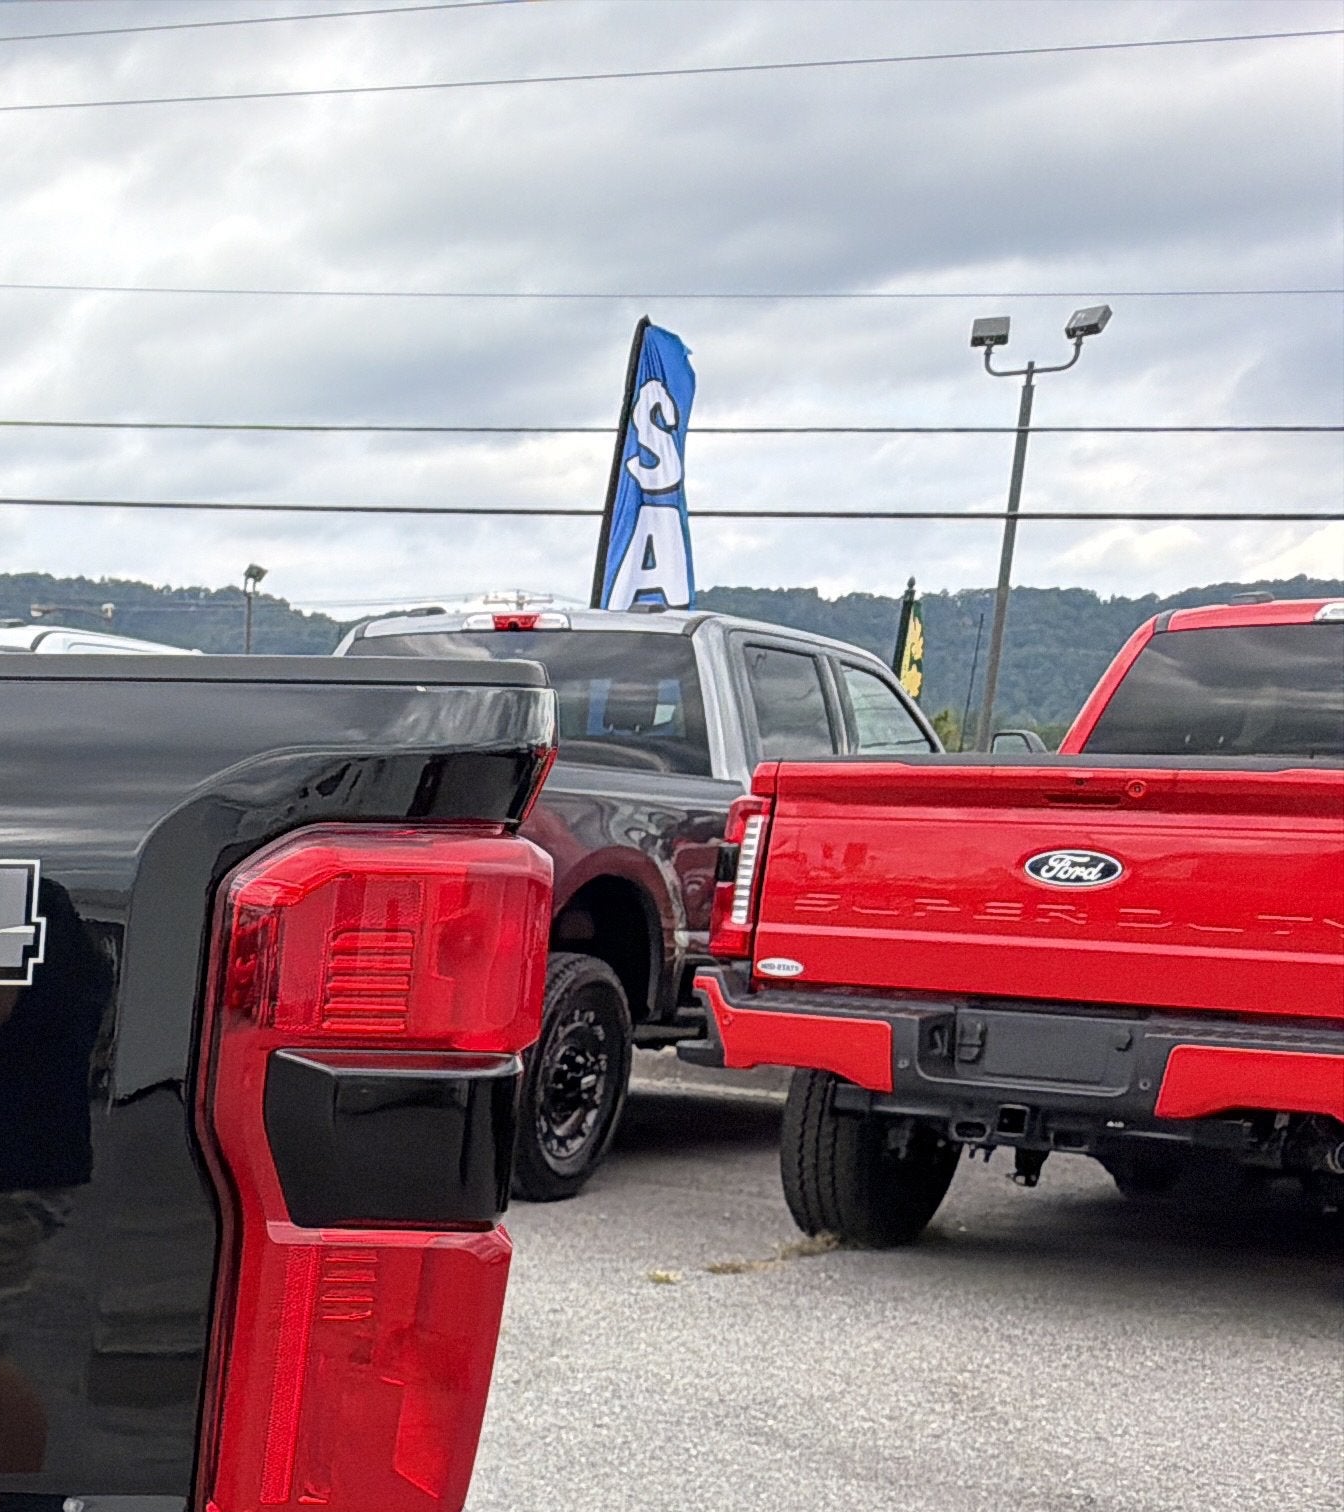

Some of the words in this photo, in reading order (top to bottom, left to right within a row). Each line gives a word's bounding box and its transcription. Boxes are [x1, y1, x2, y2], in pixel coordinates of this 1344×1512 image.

[607, 378, 691, 611] SA
[1040, 854, 1106, 881] Ford
[794, 893, 1088, 925] SUPER
